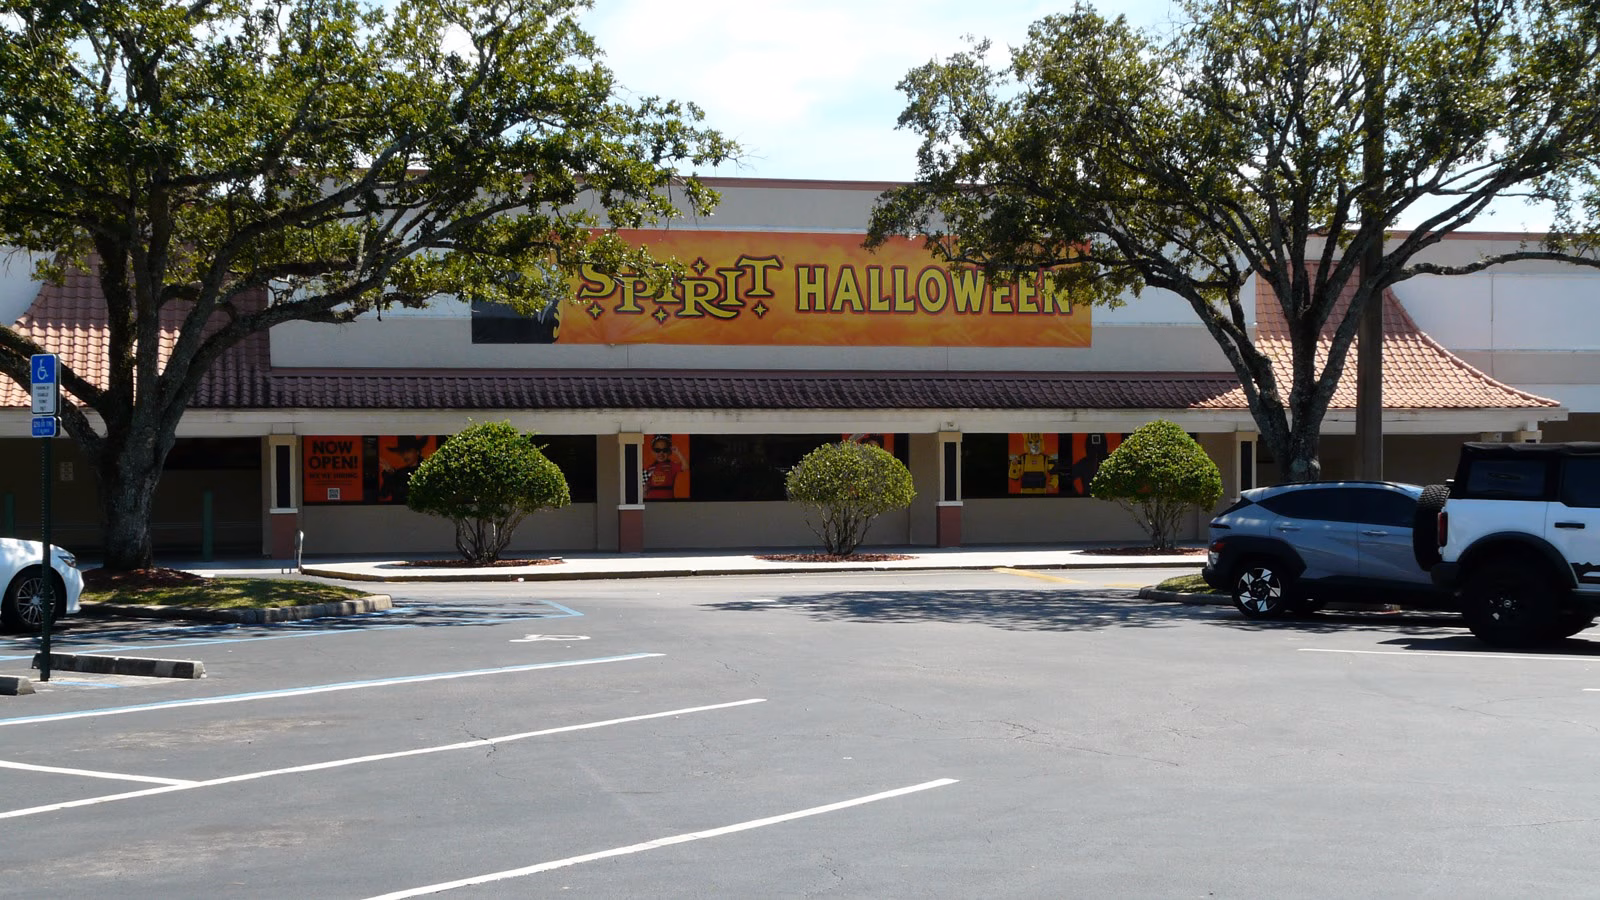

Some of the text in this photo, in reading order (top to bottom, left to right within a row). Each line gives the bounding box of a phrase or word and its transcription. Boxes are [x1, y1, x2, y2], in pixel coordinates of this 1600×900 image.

[797, 266, 1072, 314] HALLOWEEN
[312, 441, 353, 454] NOW
[309, 456, 358, 469] OPEN!
